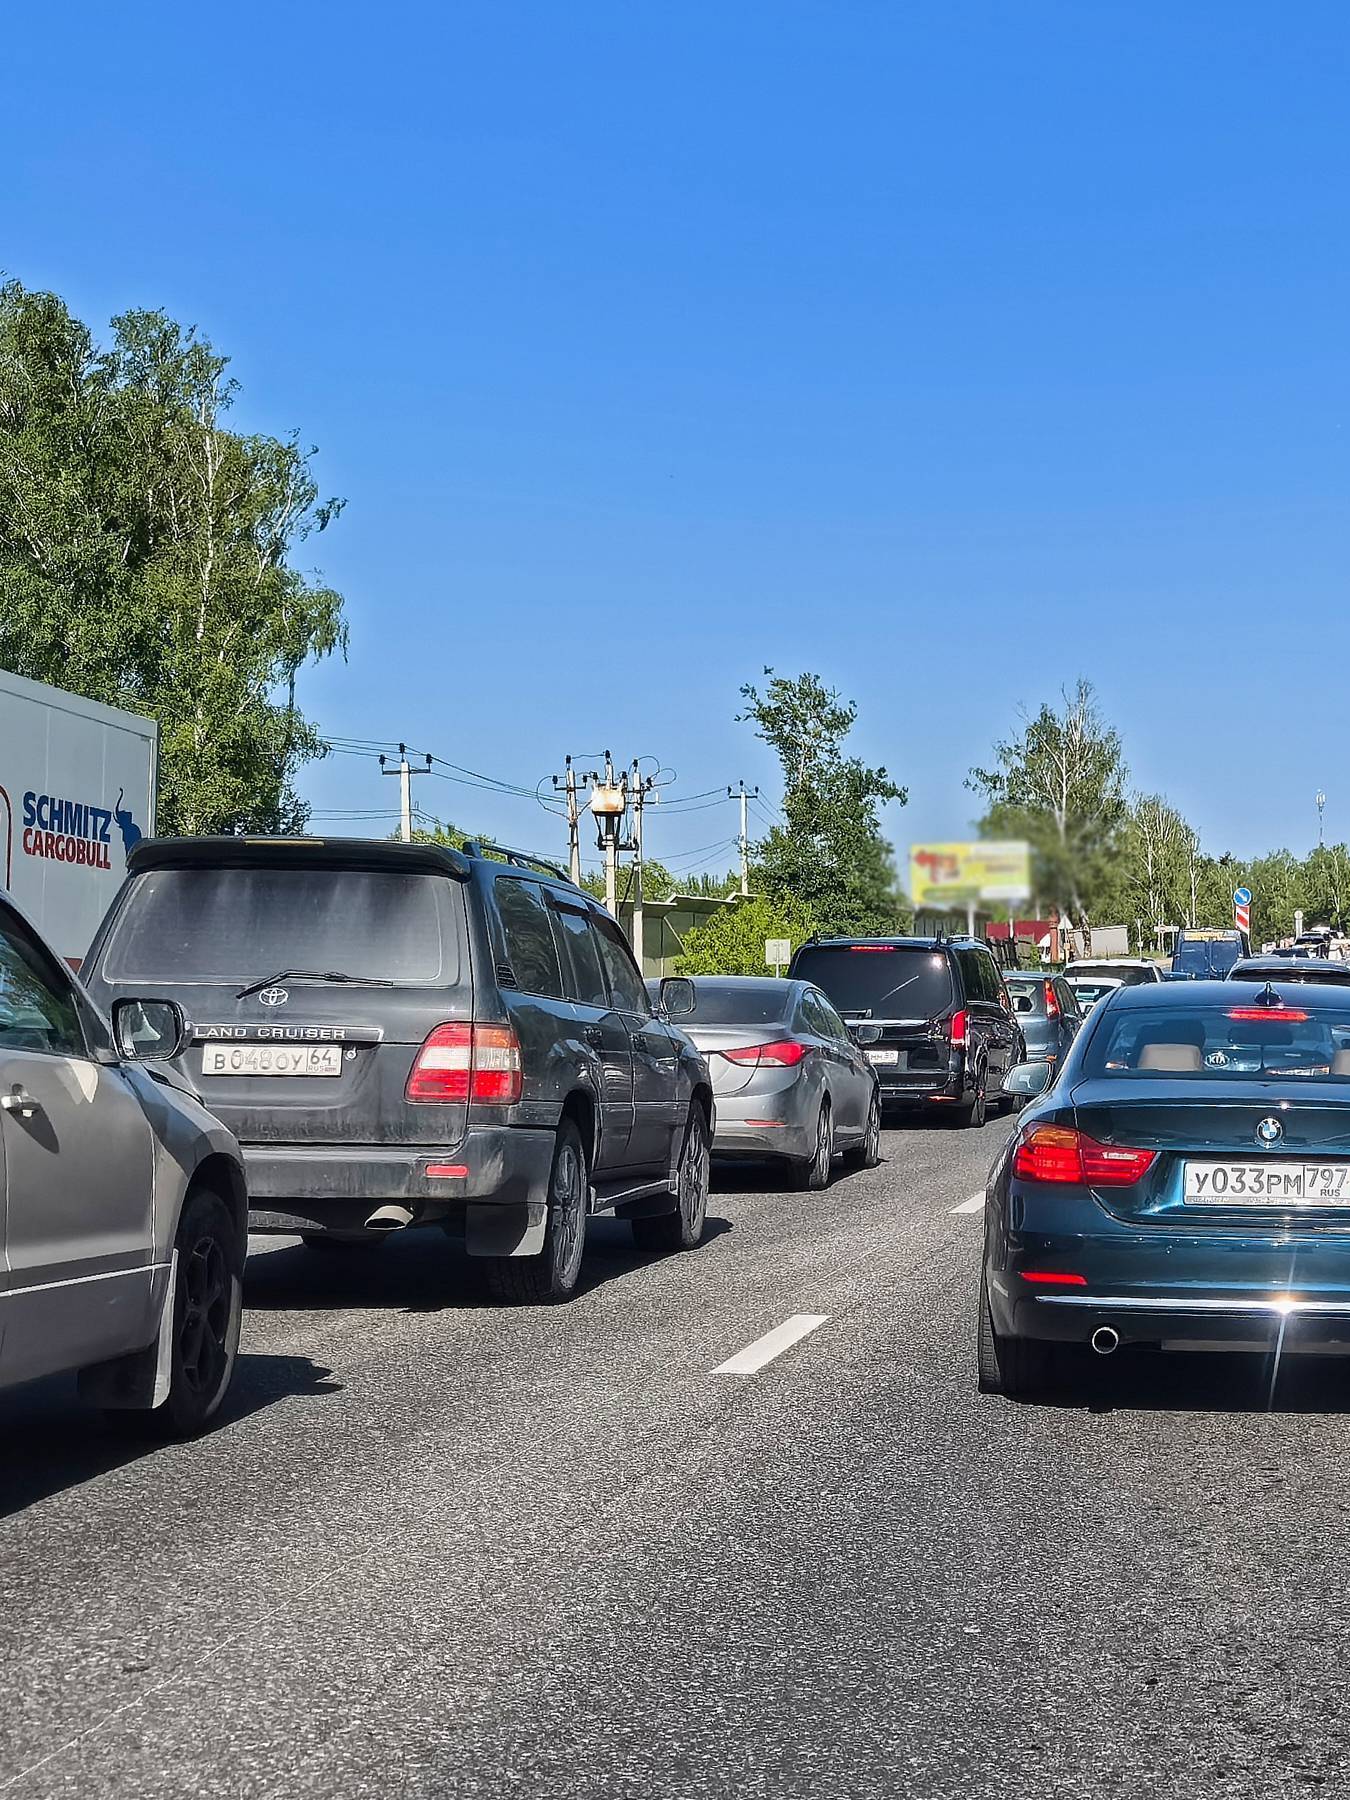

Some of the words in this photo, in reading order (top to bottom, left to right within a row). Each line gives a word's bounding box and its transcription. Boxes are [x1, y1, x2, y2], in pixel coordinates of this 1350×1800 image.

[23, 791, 112, 843] SCHMITZ
[23, 827, 111, 870] CARGOBULL
[195, 1027, 247, 1038] LAND
[257, 1027, 346, 1040] CRUISER
[1306, 1168, 1348, 1189] 797
[1320, 1188, 1341, 1197] RUS
